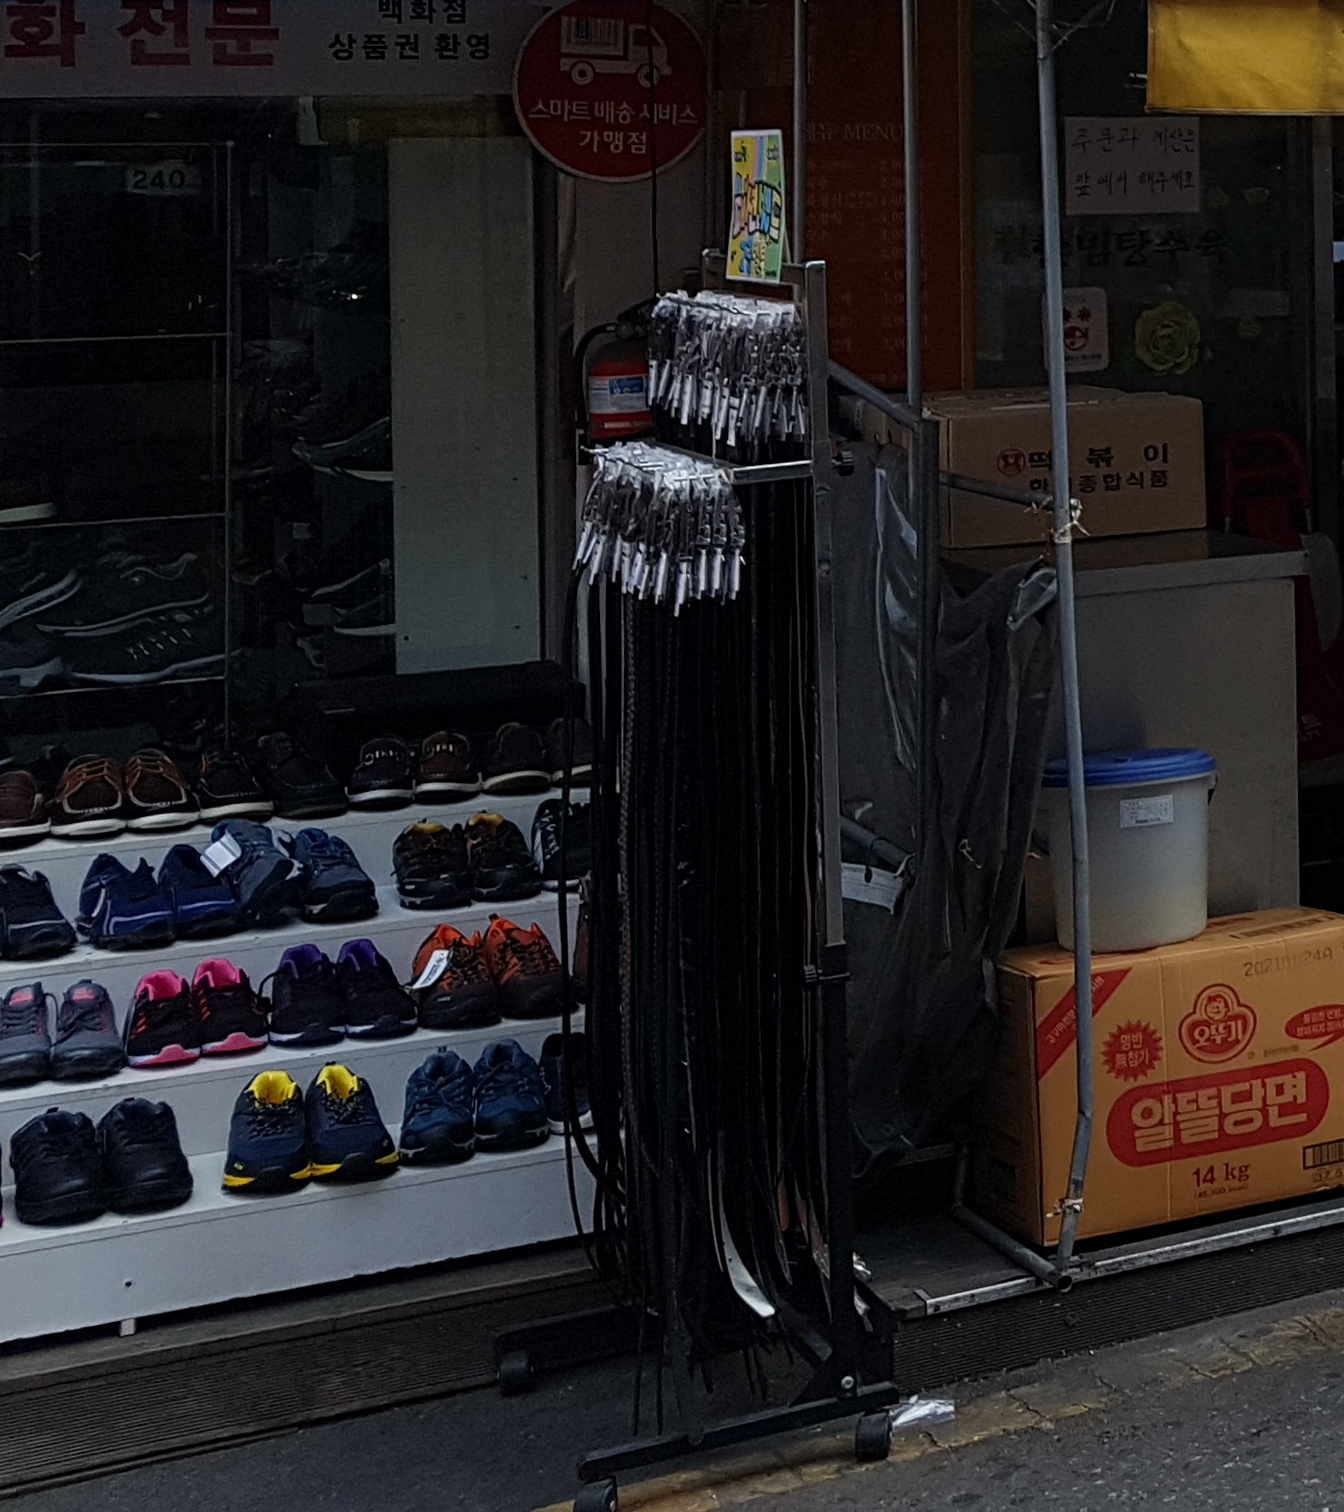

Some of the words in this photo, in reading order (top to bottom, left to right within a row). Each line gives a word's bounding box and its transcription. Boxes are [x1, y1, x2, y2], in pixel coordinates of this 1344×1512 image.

[329, 34, 419, 60] 상품권
[435, 34, 490, 60] 환영
[528, 99, 591, 122] 스마트
[594, 101, 635, 124] 배송
[580, 130, 647, 155] 가맹점
[133, 169, 185, 189] 240
[1029, 470, 1168, 493] 하종합식품
[1193, 1020, 1243, 1049] 오뚜기
[1131, 1070, 1308, 1154] 알뜰당면
[1192, 1165, 1216, 1187] 14
[1224, 1162, 1252, 1182] kg
